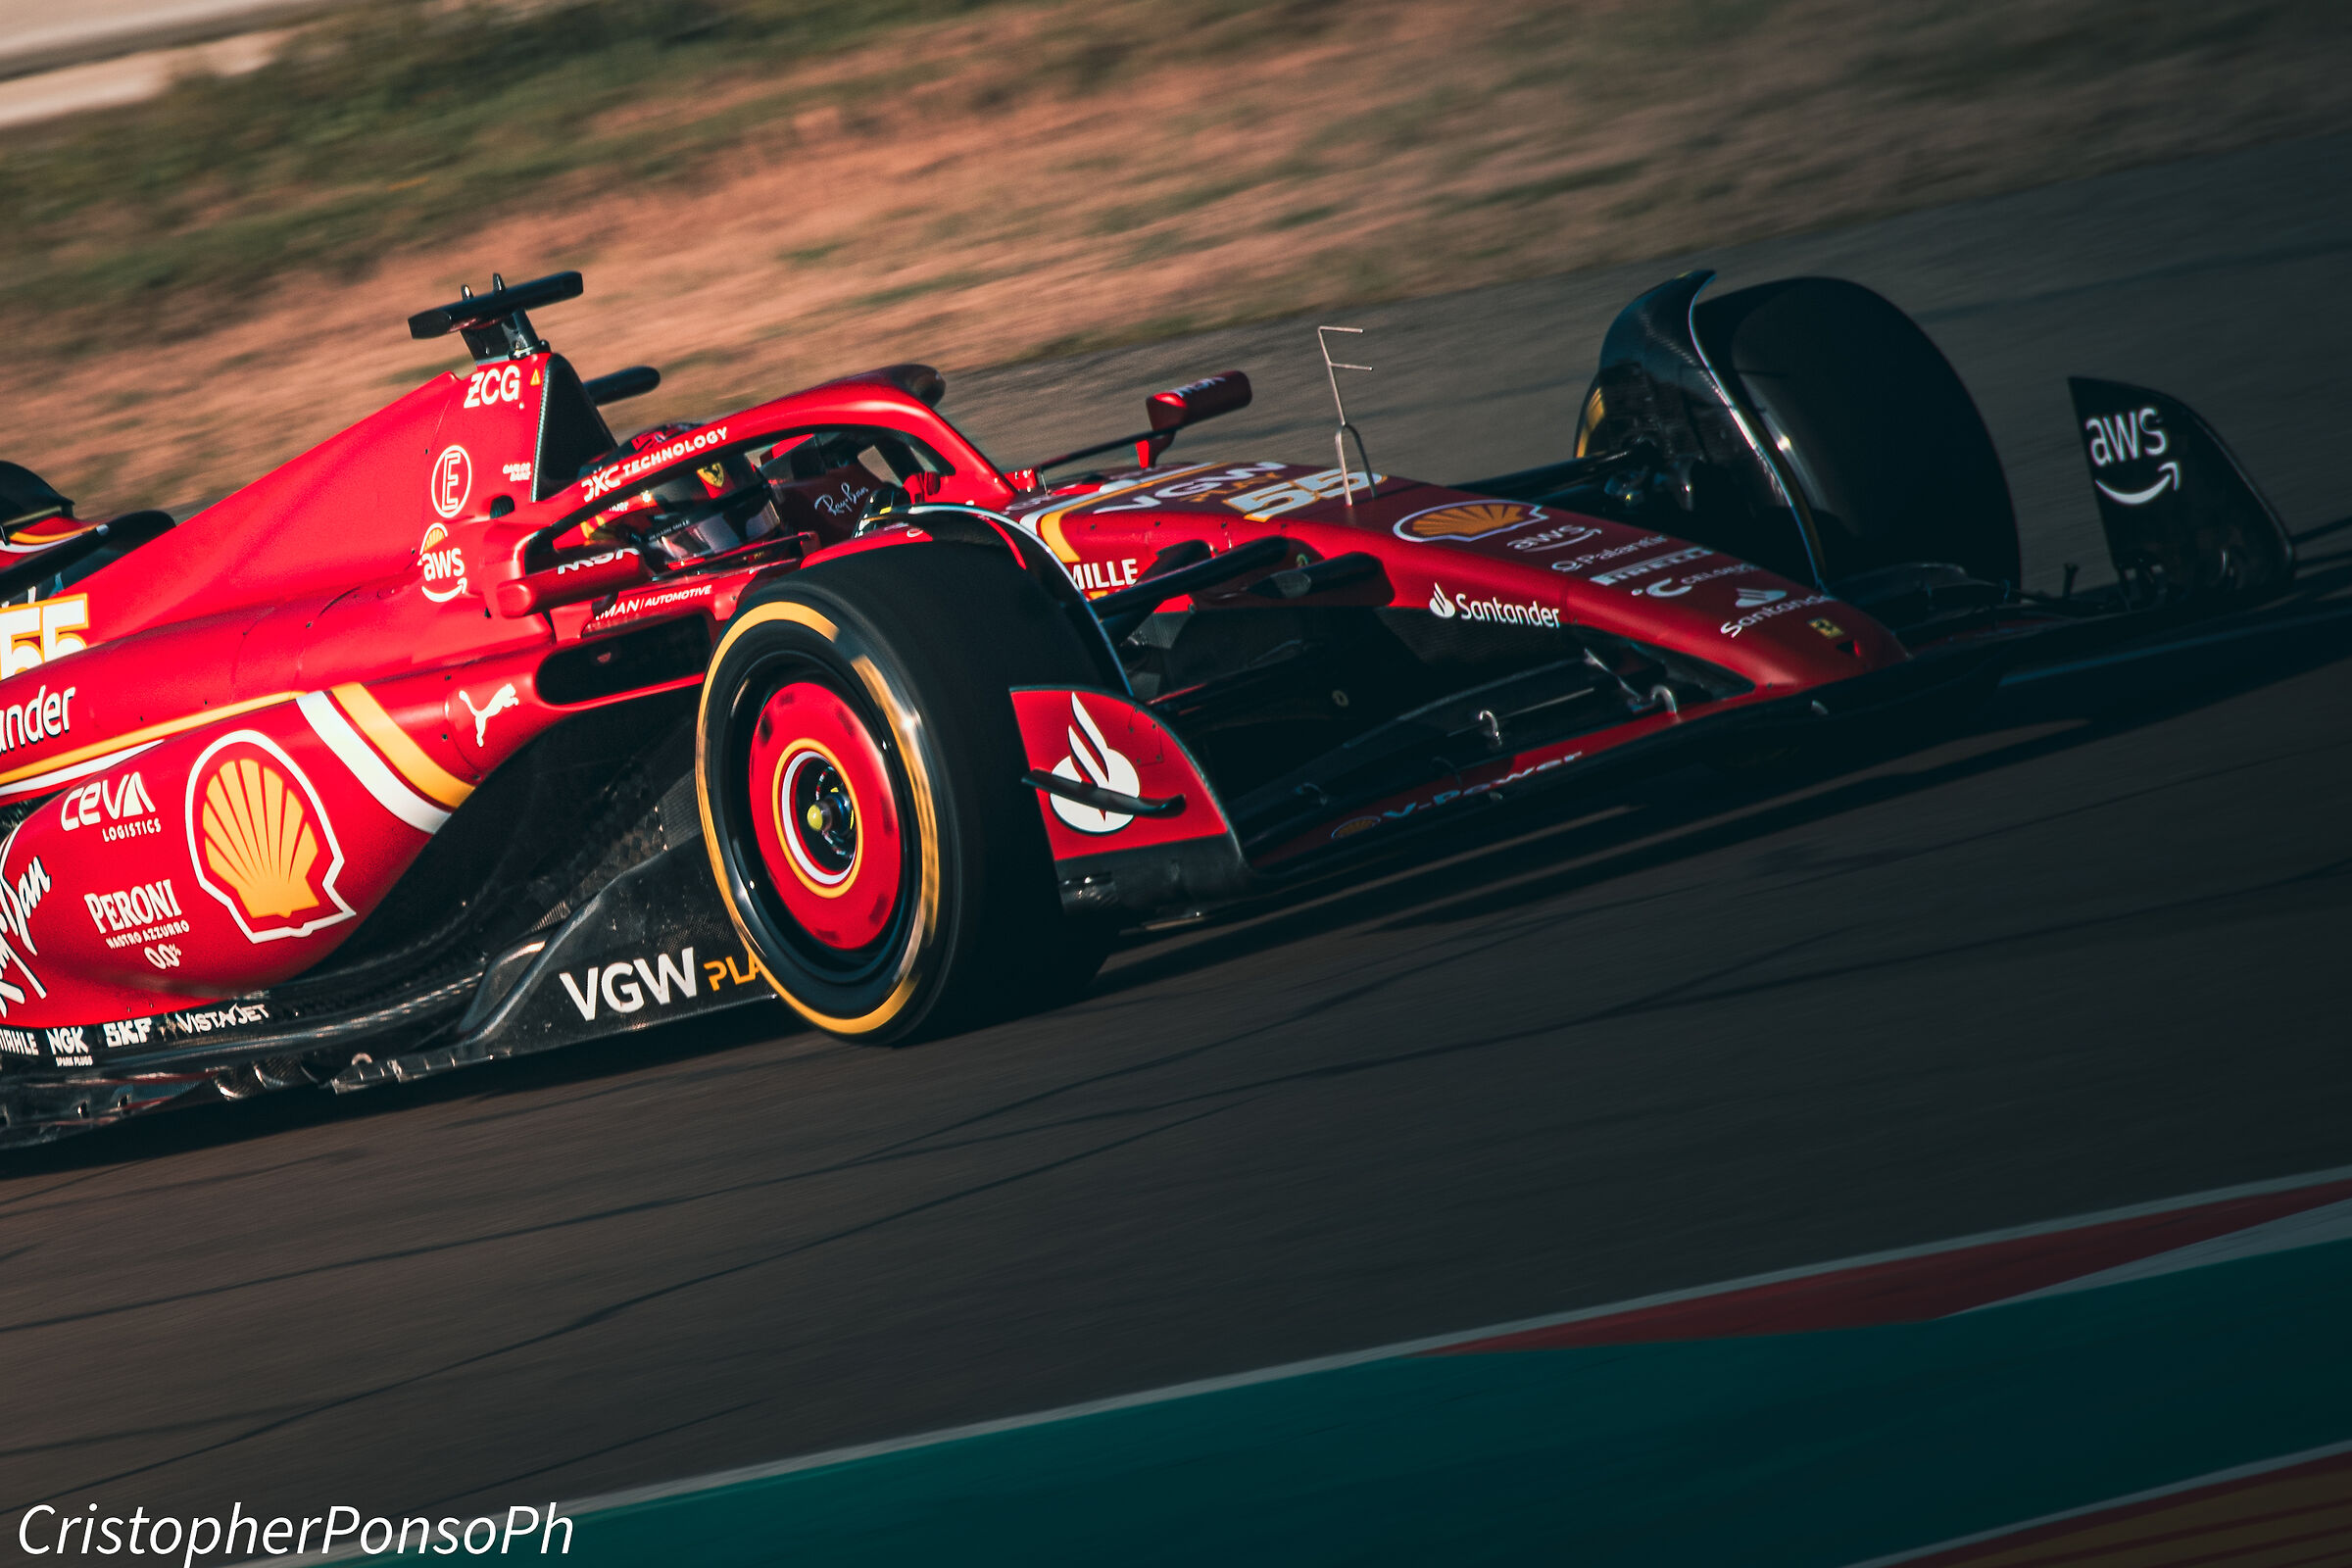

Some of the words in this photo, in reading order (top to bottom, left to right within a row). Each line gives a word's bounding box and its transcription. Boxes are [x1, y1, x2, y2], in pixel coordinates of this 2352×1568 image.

[464, 365, 520, 409] ZCG
[623, 426, 729, 477] TECHNOLOGY
[2085, 407, 2169, 467] aws
[1093, 462, 1288, 514] VGW
[1223, 468, 1388, 523] 55
[422, 548, 466, 582] aws
[596, 598, 639, 621] MAN
[645, 584, 712, 608] AUTOMOTIVE
[1455, 592, 1560, 629] Santander
[1720, 594, 1840, 639] Santand
[61, 771, 156, 832] CEVA
[102, 817, 162, 843] LOGISTICS
[83, 878, 182, 935] PERONI
[105, 931, 143, 950] NASTRO
[142, 919, 190, 942] AZZURRO
[560, 947, 697, 1021] VGW
[45, 1025, 89, 1055] NGK
[102, 1016, 152, 1048] SKF
